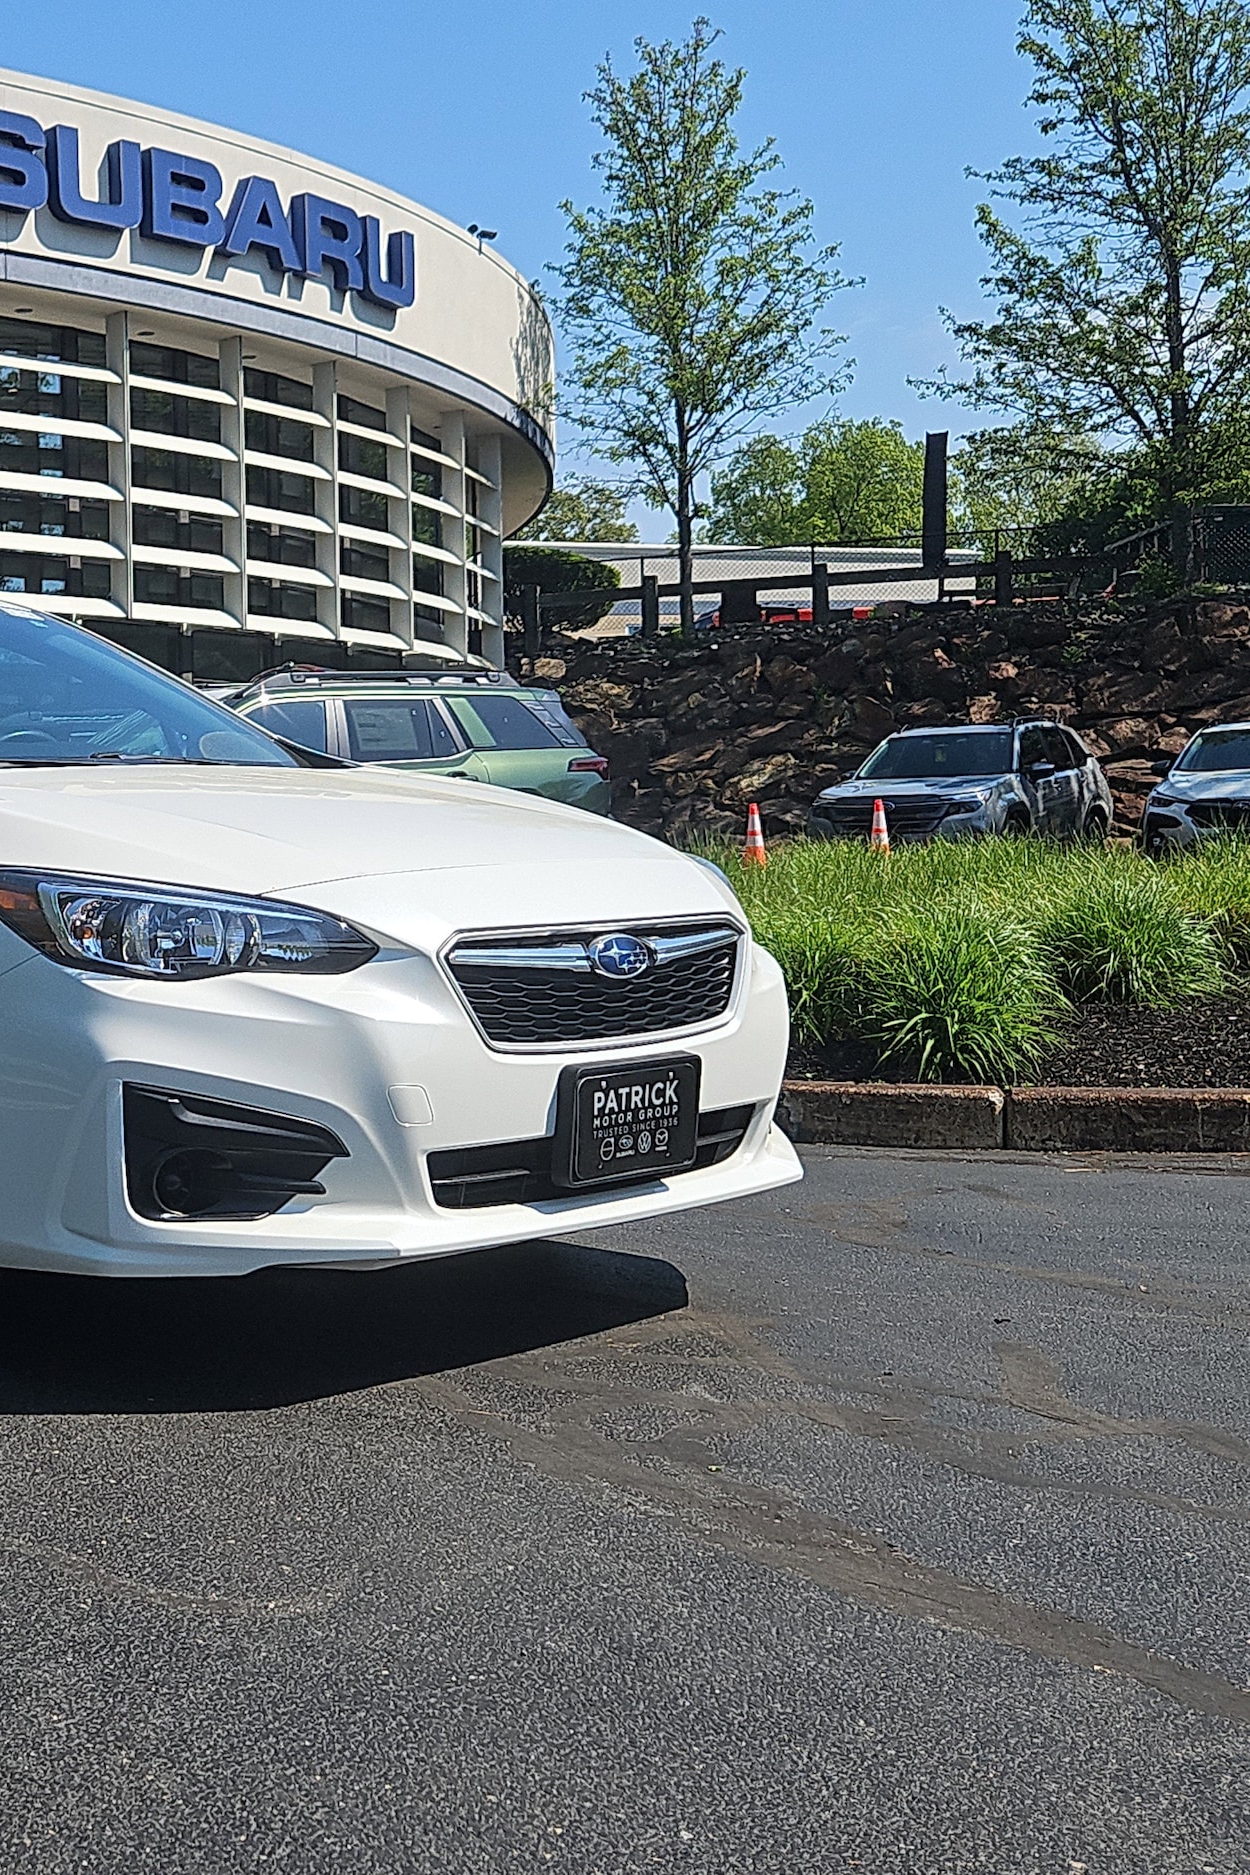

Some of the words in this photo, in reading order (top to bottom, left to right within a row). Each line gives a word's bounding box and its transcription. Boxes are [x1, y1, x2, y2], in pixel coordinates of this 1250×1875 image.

[594, 1080, 679, 1116] PATRICK
[593, 1112, 633, 1129] MOTOR
[639, 1105, 678, 1120] GROUP
[593, 1126, 629, 1139] TRUSTED
[632, 1121, 656, 1132] SINCE
